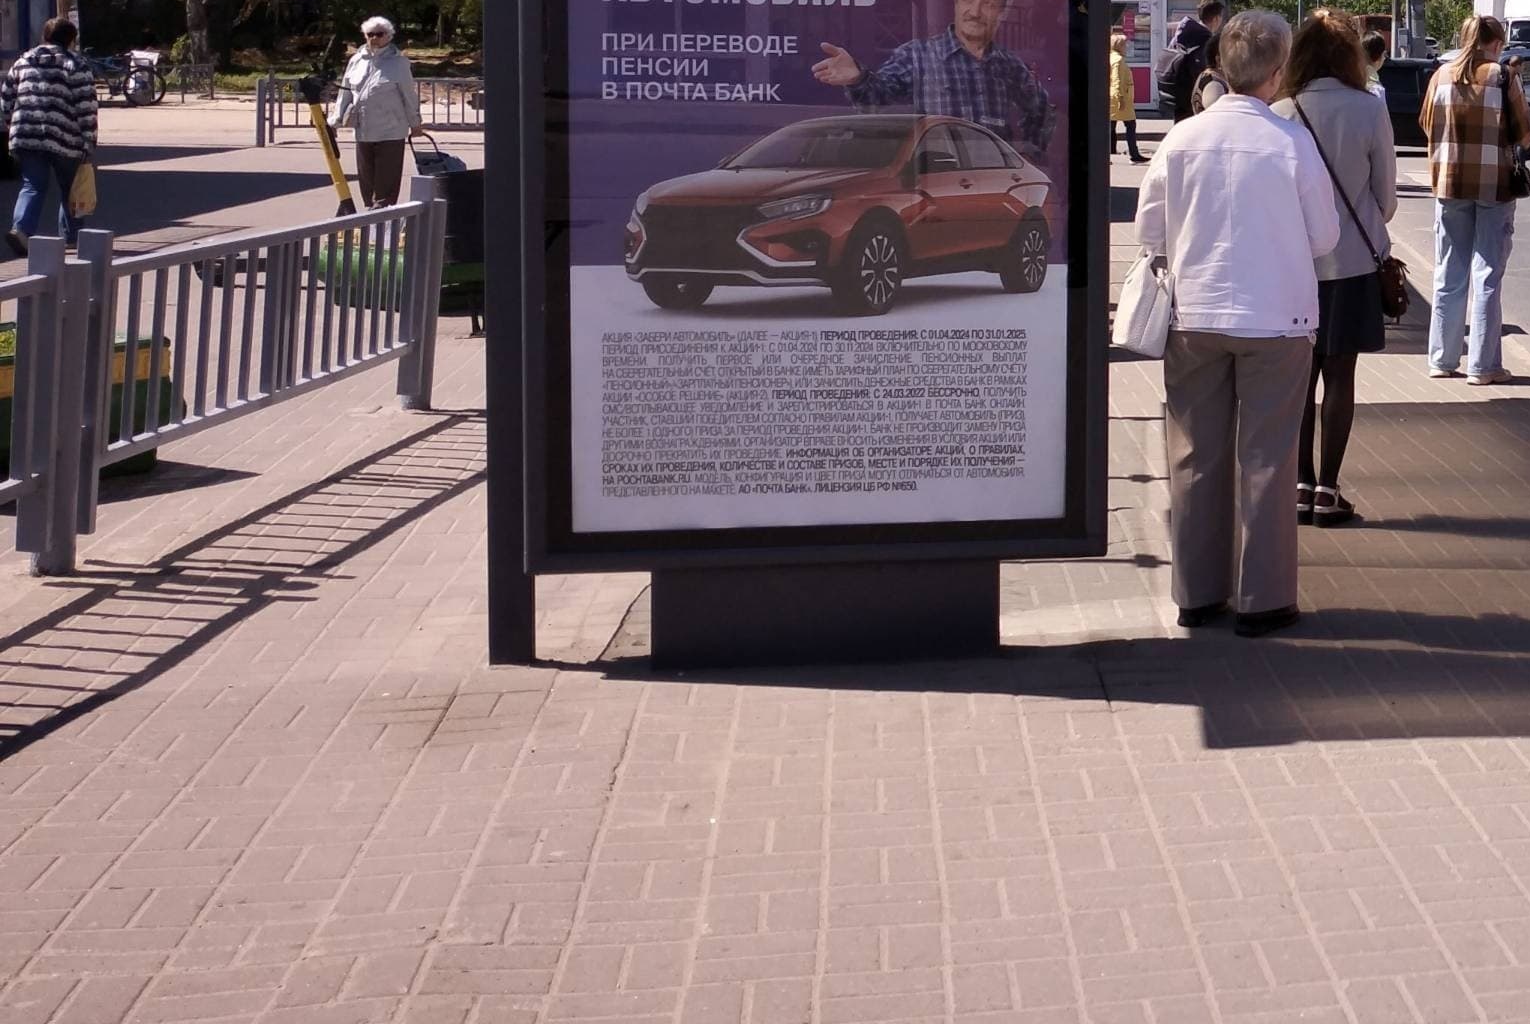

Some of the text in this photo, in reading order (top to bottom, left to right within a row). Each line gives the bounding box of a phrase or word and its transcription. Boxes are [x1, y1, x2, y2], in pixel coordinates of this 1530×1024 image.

[602, 32, 798, 57] ПРИ ПЕРЕВОДЕ
[602, 57, 709, 77] ПЕНСИИ
[602, 81, 782, 102] В ПОЧТА БАНК
[820, 330, 856, 340] ПЕРИОД
[971, 329, 984, 339] ПО
[820, 342, 832, 352] ПО
[948, 340, 960, 351] ПО
[716, 354, 752, 365] ПЕРВОЕ
[791, 353, 844, 364] ОЧЕРЕДНОЕ
[854, 352, 912, 364] ЗАЧИСЛЕНИЕ
[922, 352, 983, 363] ПЕНСИОННЫХ
[993, 351, 1026, 362] ВЫПЛАТ
[772, 389, 807, 400] ПЕРИОД
